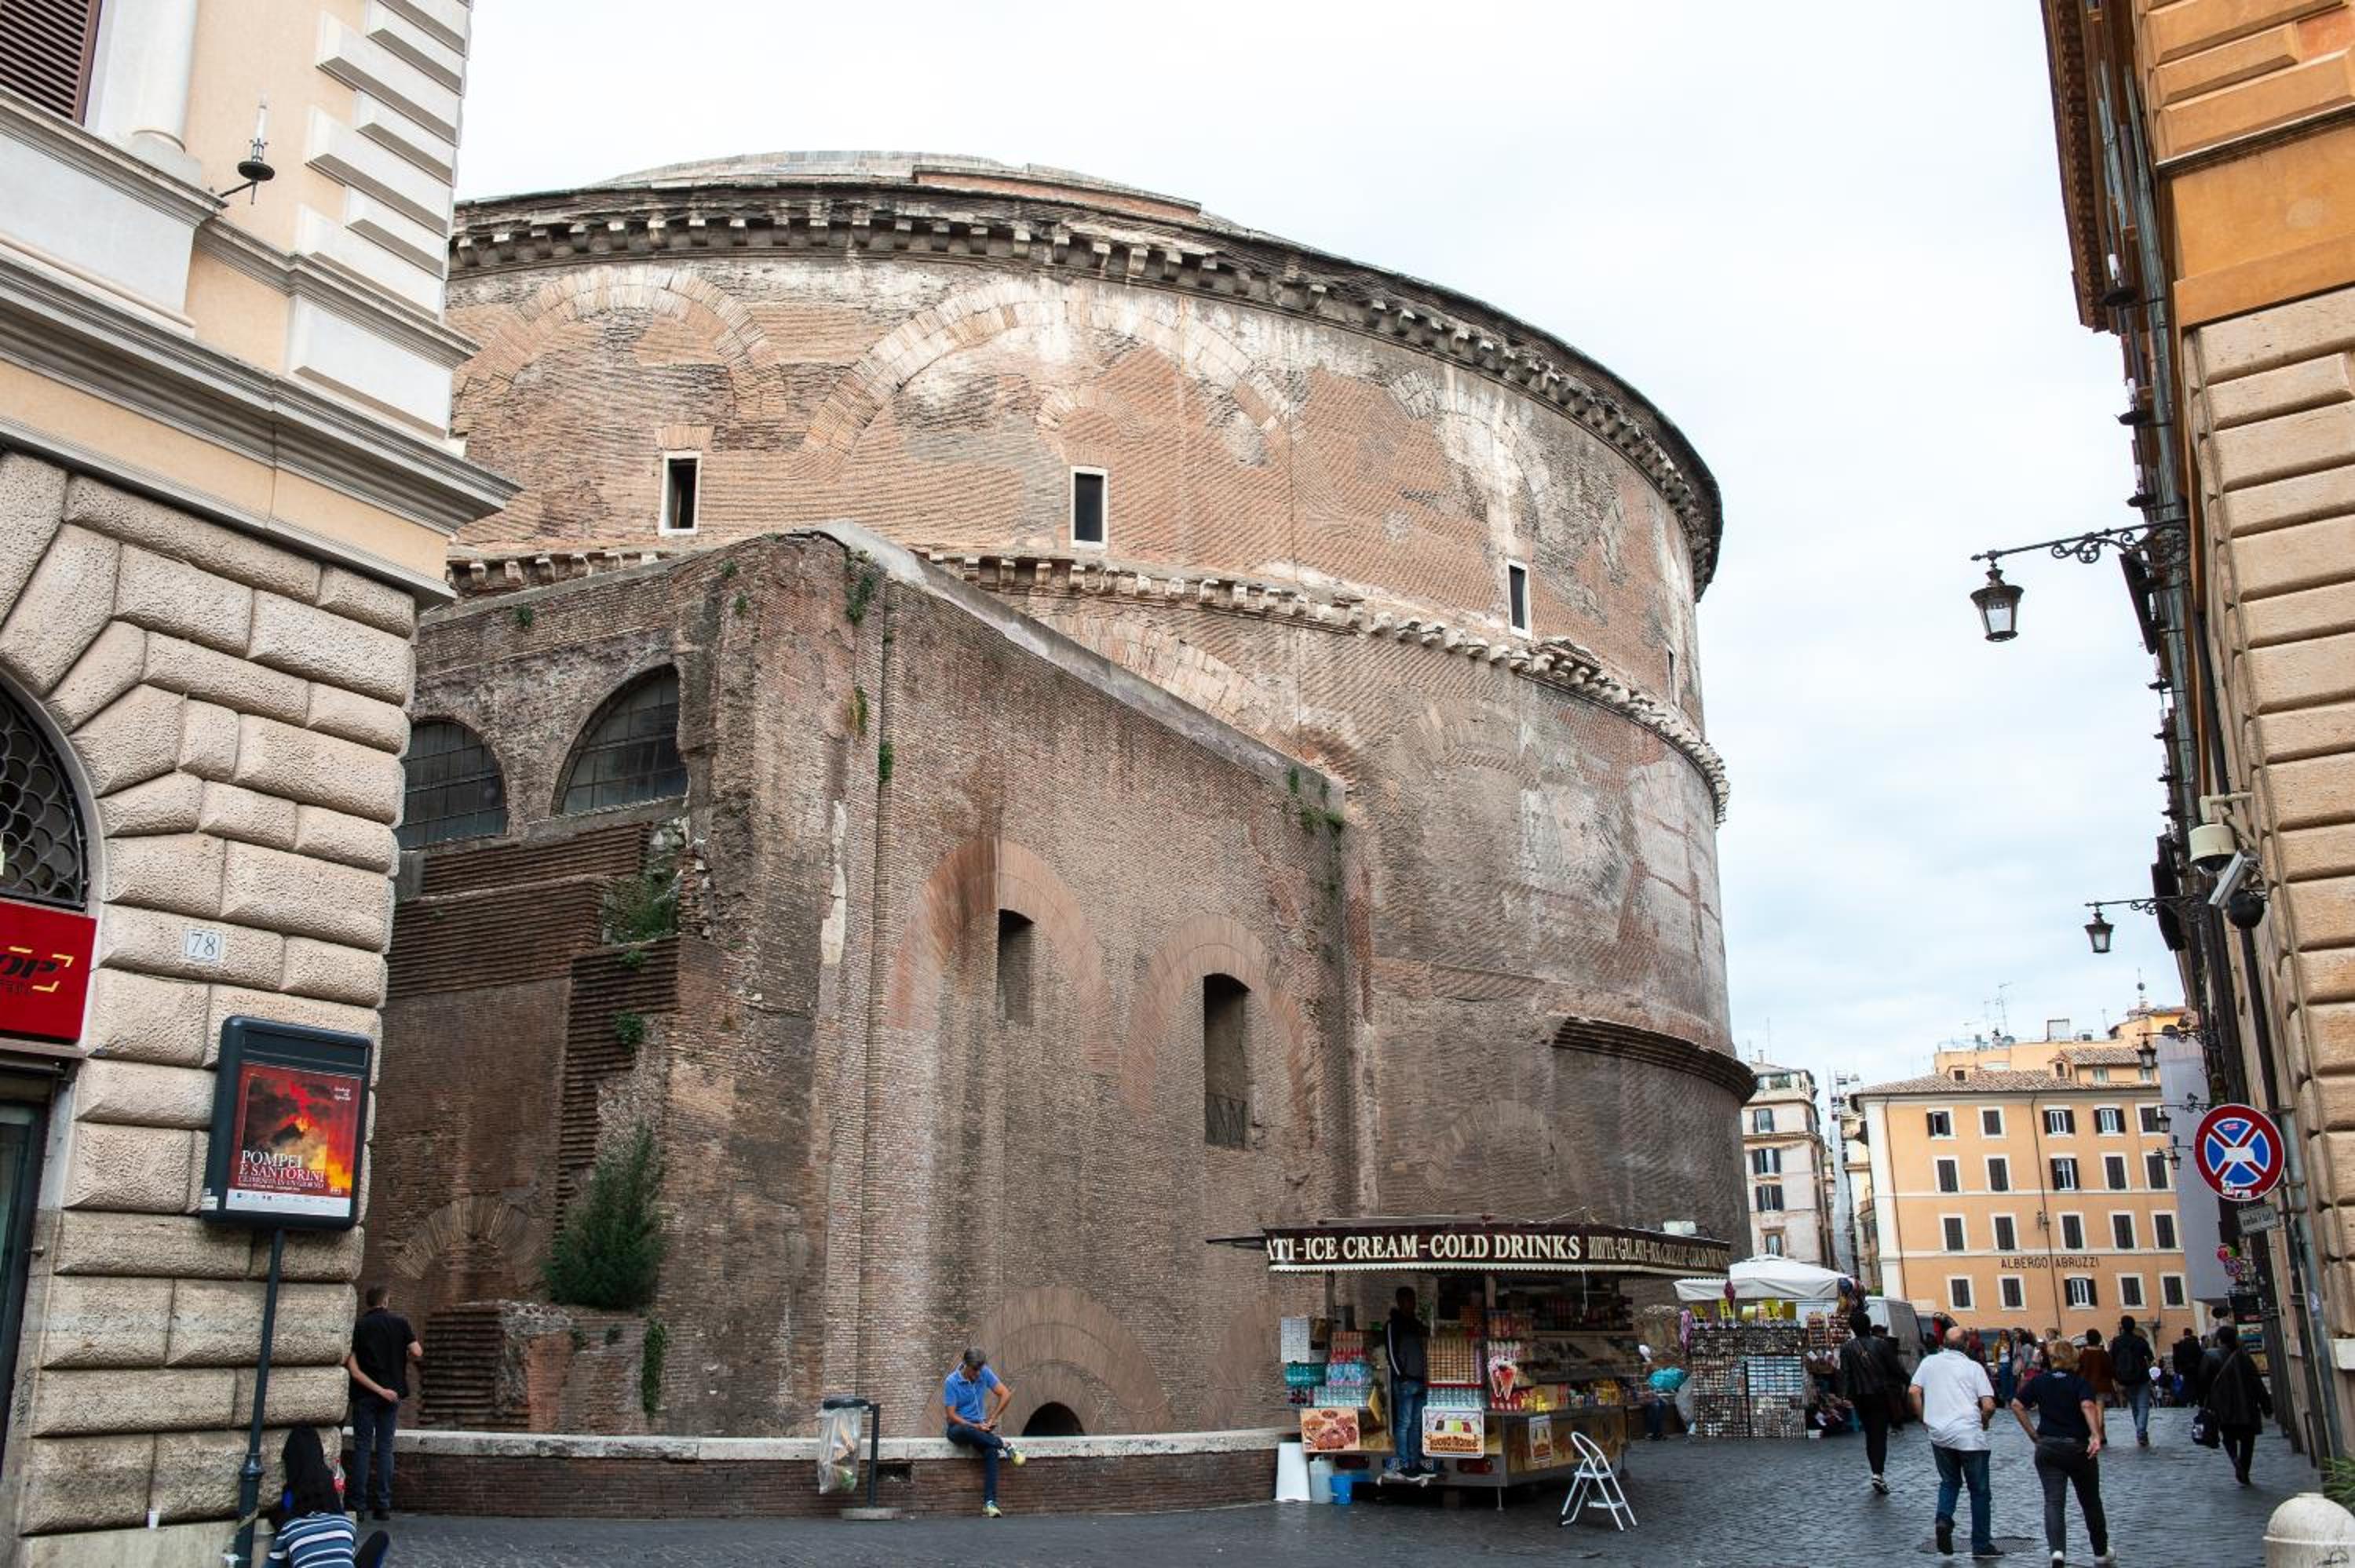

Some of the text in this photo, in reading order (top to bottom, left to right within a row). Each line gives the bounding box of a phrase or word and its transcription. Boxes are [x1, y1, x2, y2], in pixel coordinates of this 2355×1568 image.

[191, 932, 216, 956] 78
[241, 1150, 303, 1169] POMPEI
[239, 1164, 325, 1183] E SANTORINI
[1495, 1235, 1581, 1260] DRINKS
[2001, 1256, 2100, 1269] ALBERGO ABRUZZI
